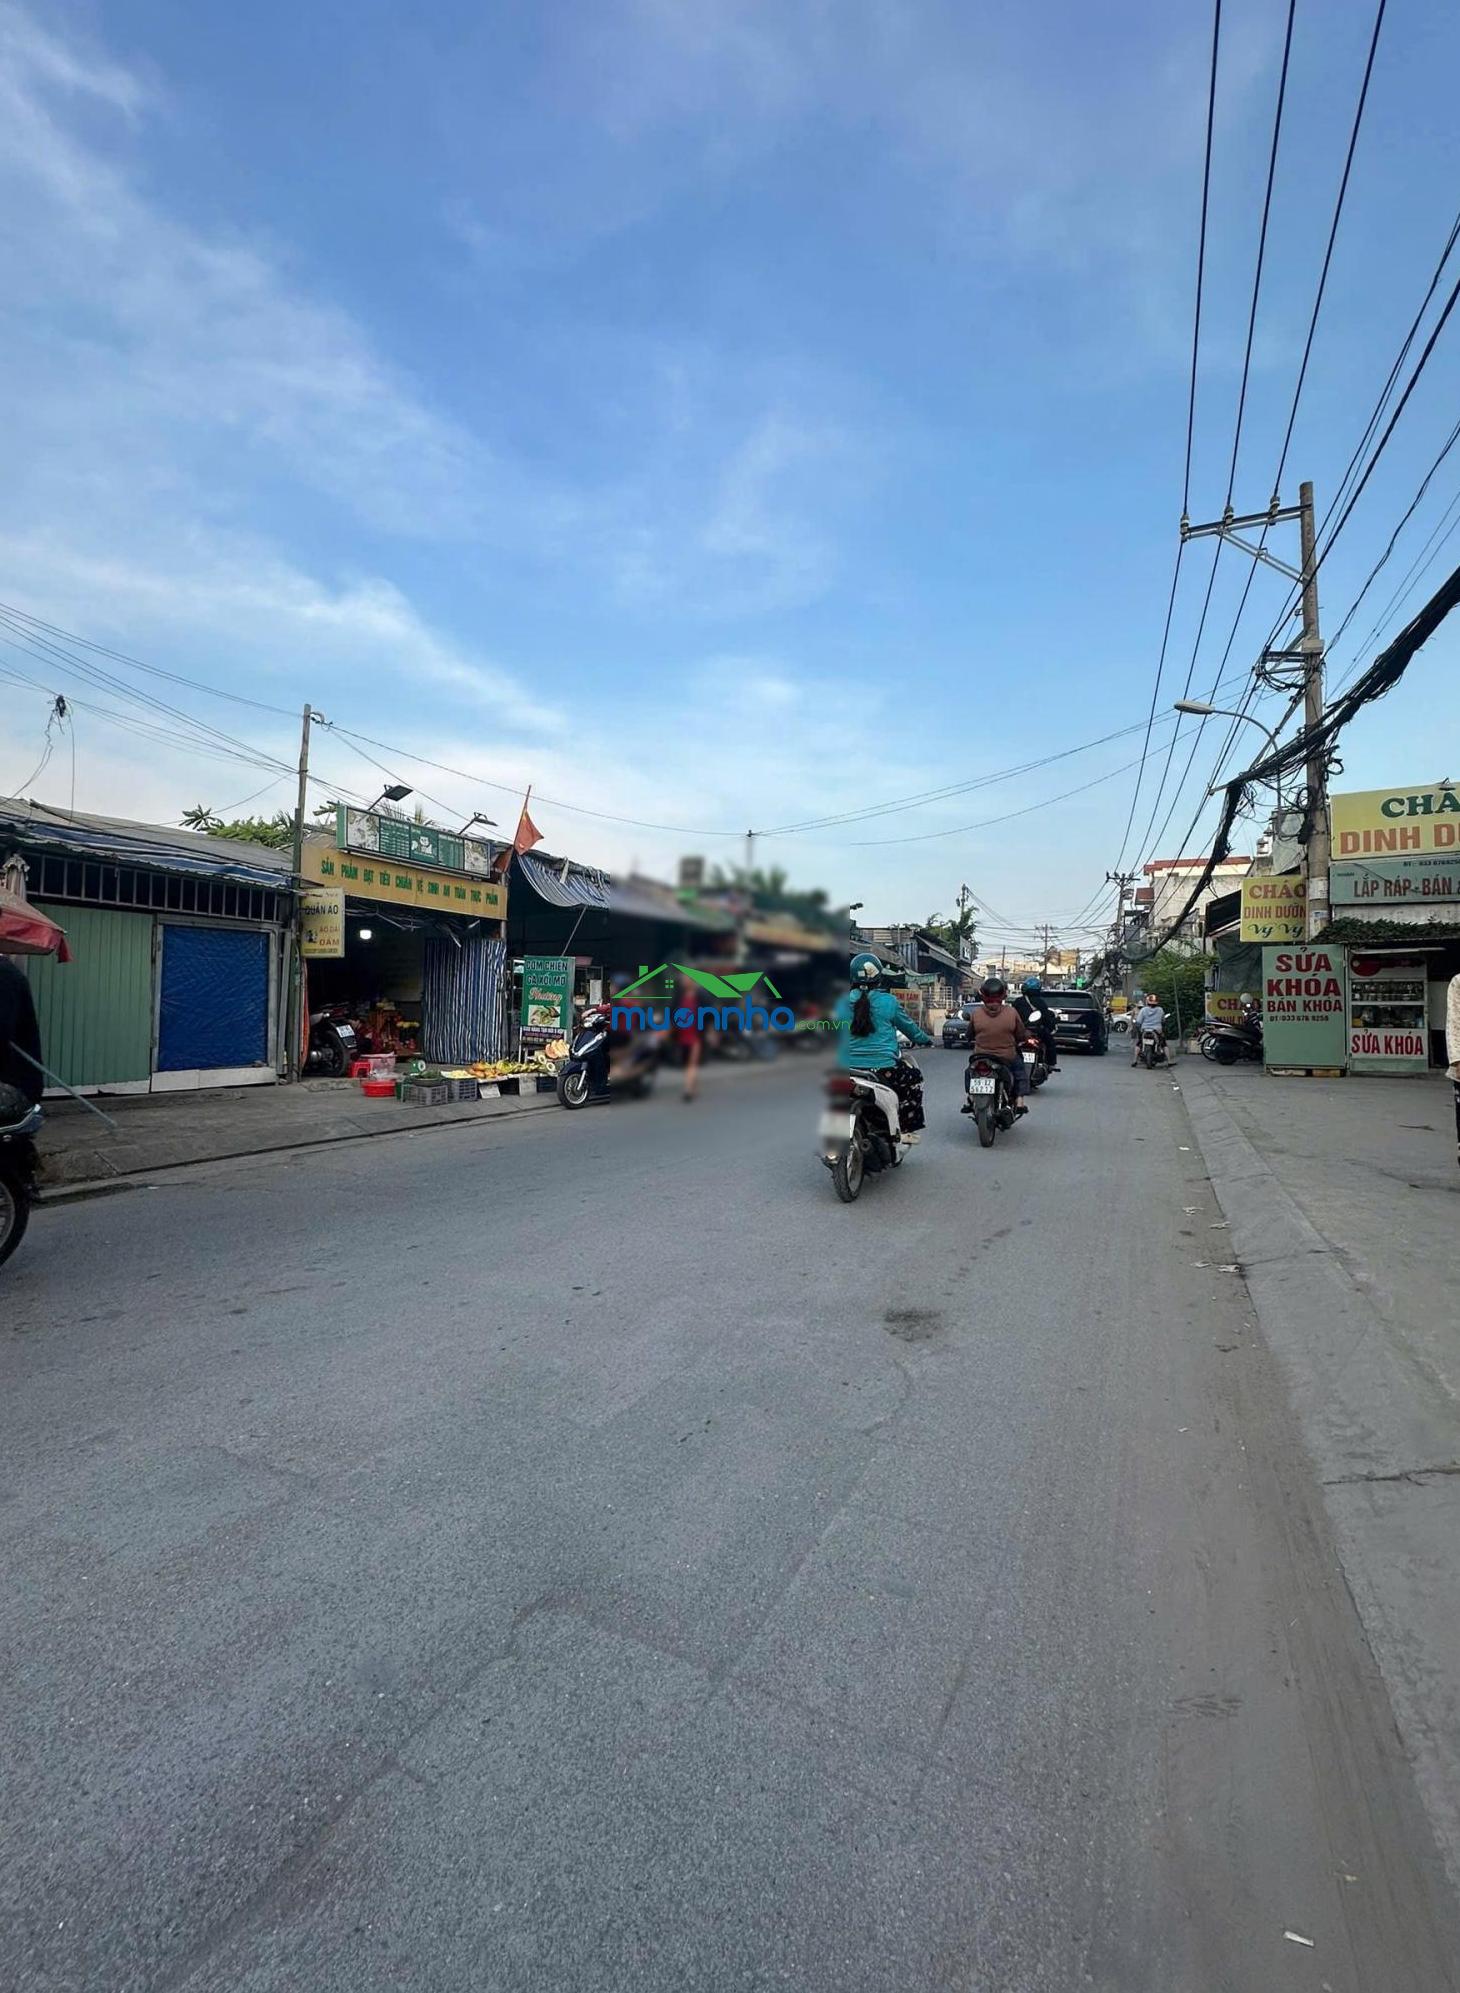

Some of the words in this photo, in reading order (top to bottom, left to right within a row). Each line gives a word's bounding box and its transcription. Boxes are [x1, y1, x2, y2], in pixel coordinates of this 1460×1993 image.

[1340, 826, 1421, 855] DINH
[1433, 823, 1460, 848] D
[1249, 880, 1306, 899] CHÁO
[1354, 874, 1379, 897] LẮP
[1384, 875, 1412, 897] RÁP
[1422, 874, 1452, 896] BÁN
[1244, 906, 1272, 919] DINH
[1276, 947, 1332, 972] SỬA
[1267, 973, 1342, 997] KHÓA
[1217, 998, 1262, 1010] CHO
[1267, 998, 1297, 1012] BÁN
[1303, 997, 1343, 1012] KHÓA
[1352, 1029, 1381, 1055] SỬA
[1384, 1032, 1424, 1056] KHÓA
